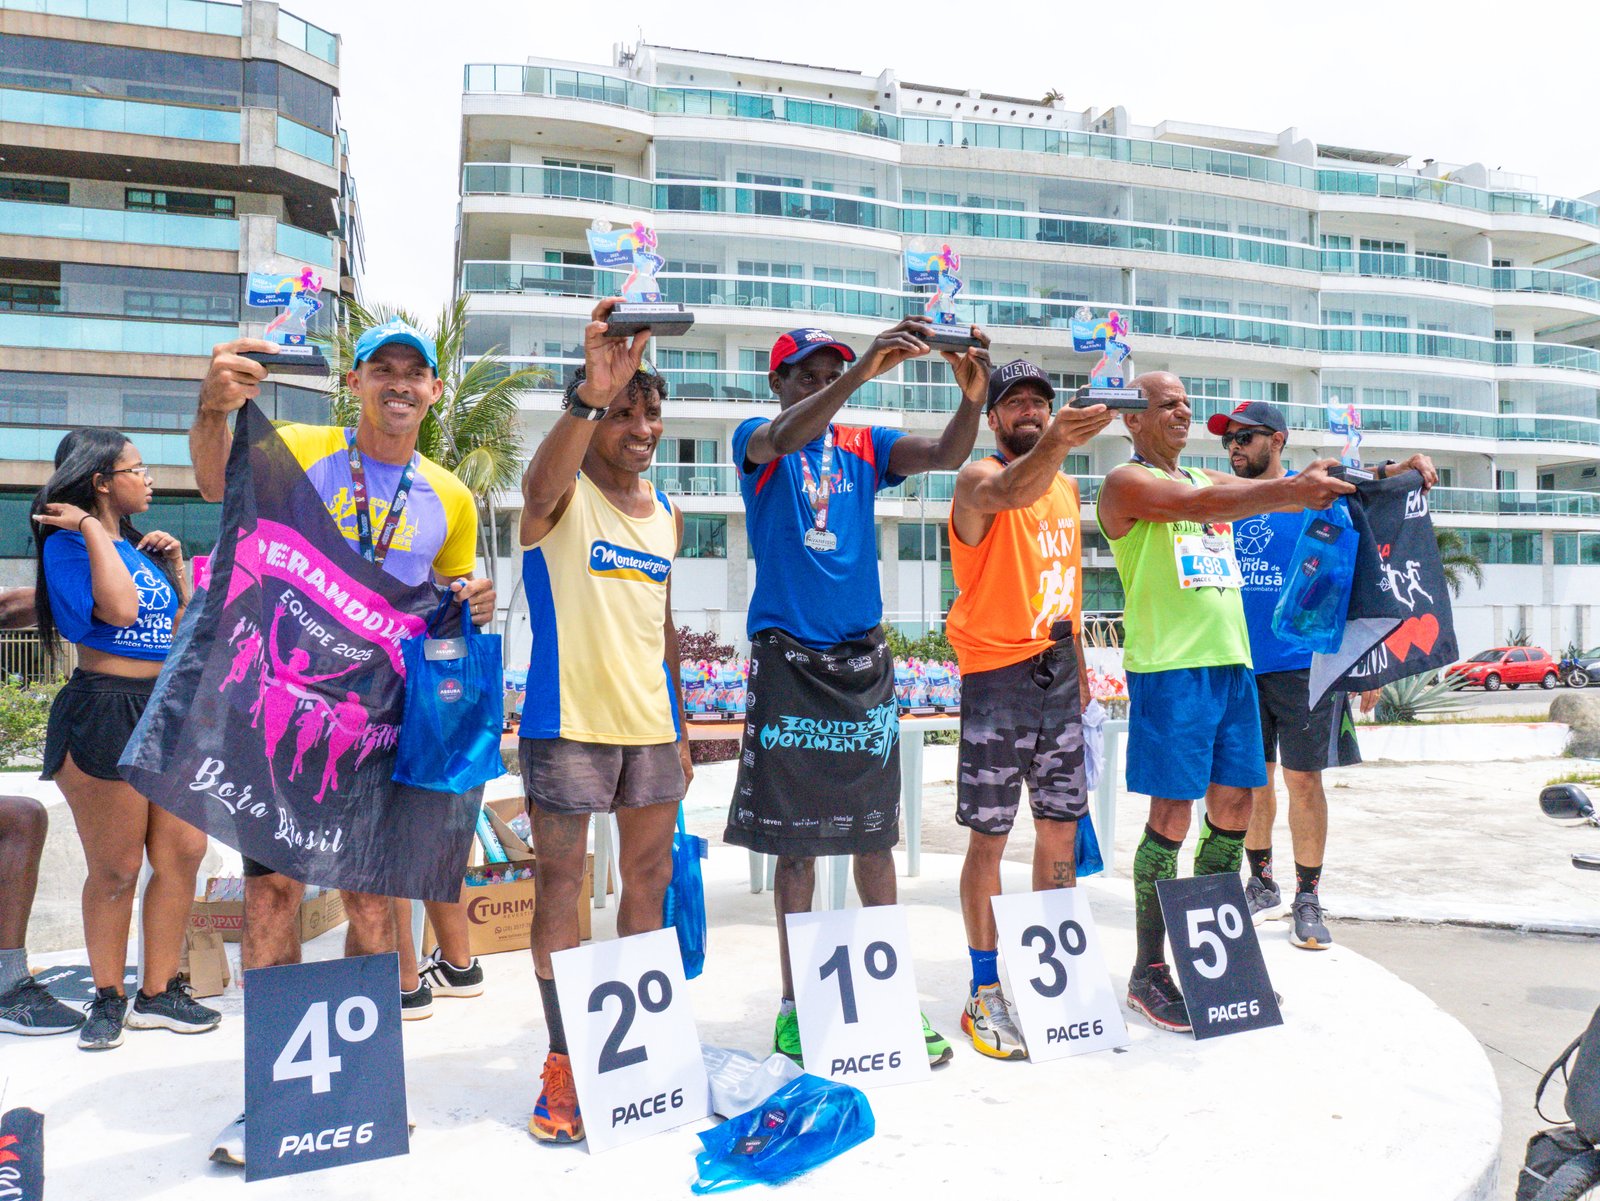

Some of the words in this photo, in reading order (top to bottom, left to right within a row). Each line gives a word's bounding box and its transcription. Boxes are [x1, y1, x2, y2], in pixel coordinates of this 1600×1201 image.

[1002, 362, 1040, 382] NETS
[1192, 555, 1223, 575] 498
[1271, 564, 1280, 572] de
[280, 589, 335, 647] EQUIPE
[331, 643, 374, 661] 2025
[189, 757, 269, 818] Bora
[274, 807, 343, 853] Brasil
[763, 818, 782, 827] seven
[1208, 1001, 1249, 1024] PACE
[1250, 999, 1260, 1017] 6
[1046, 1021, 1090, 1045] PACE
[1093, 1019, 1103, 1036] 6
[831, 1053, 885, 1076] PACE
[889, 1051, 901, 1069] 6
[612, 1092, 666, 1129] PACE
[671, 1087, 683, 1109] 6
[278, 1125, 353, 1158] PACE
[356, 1121, 374, 1144] 6
